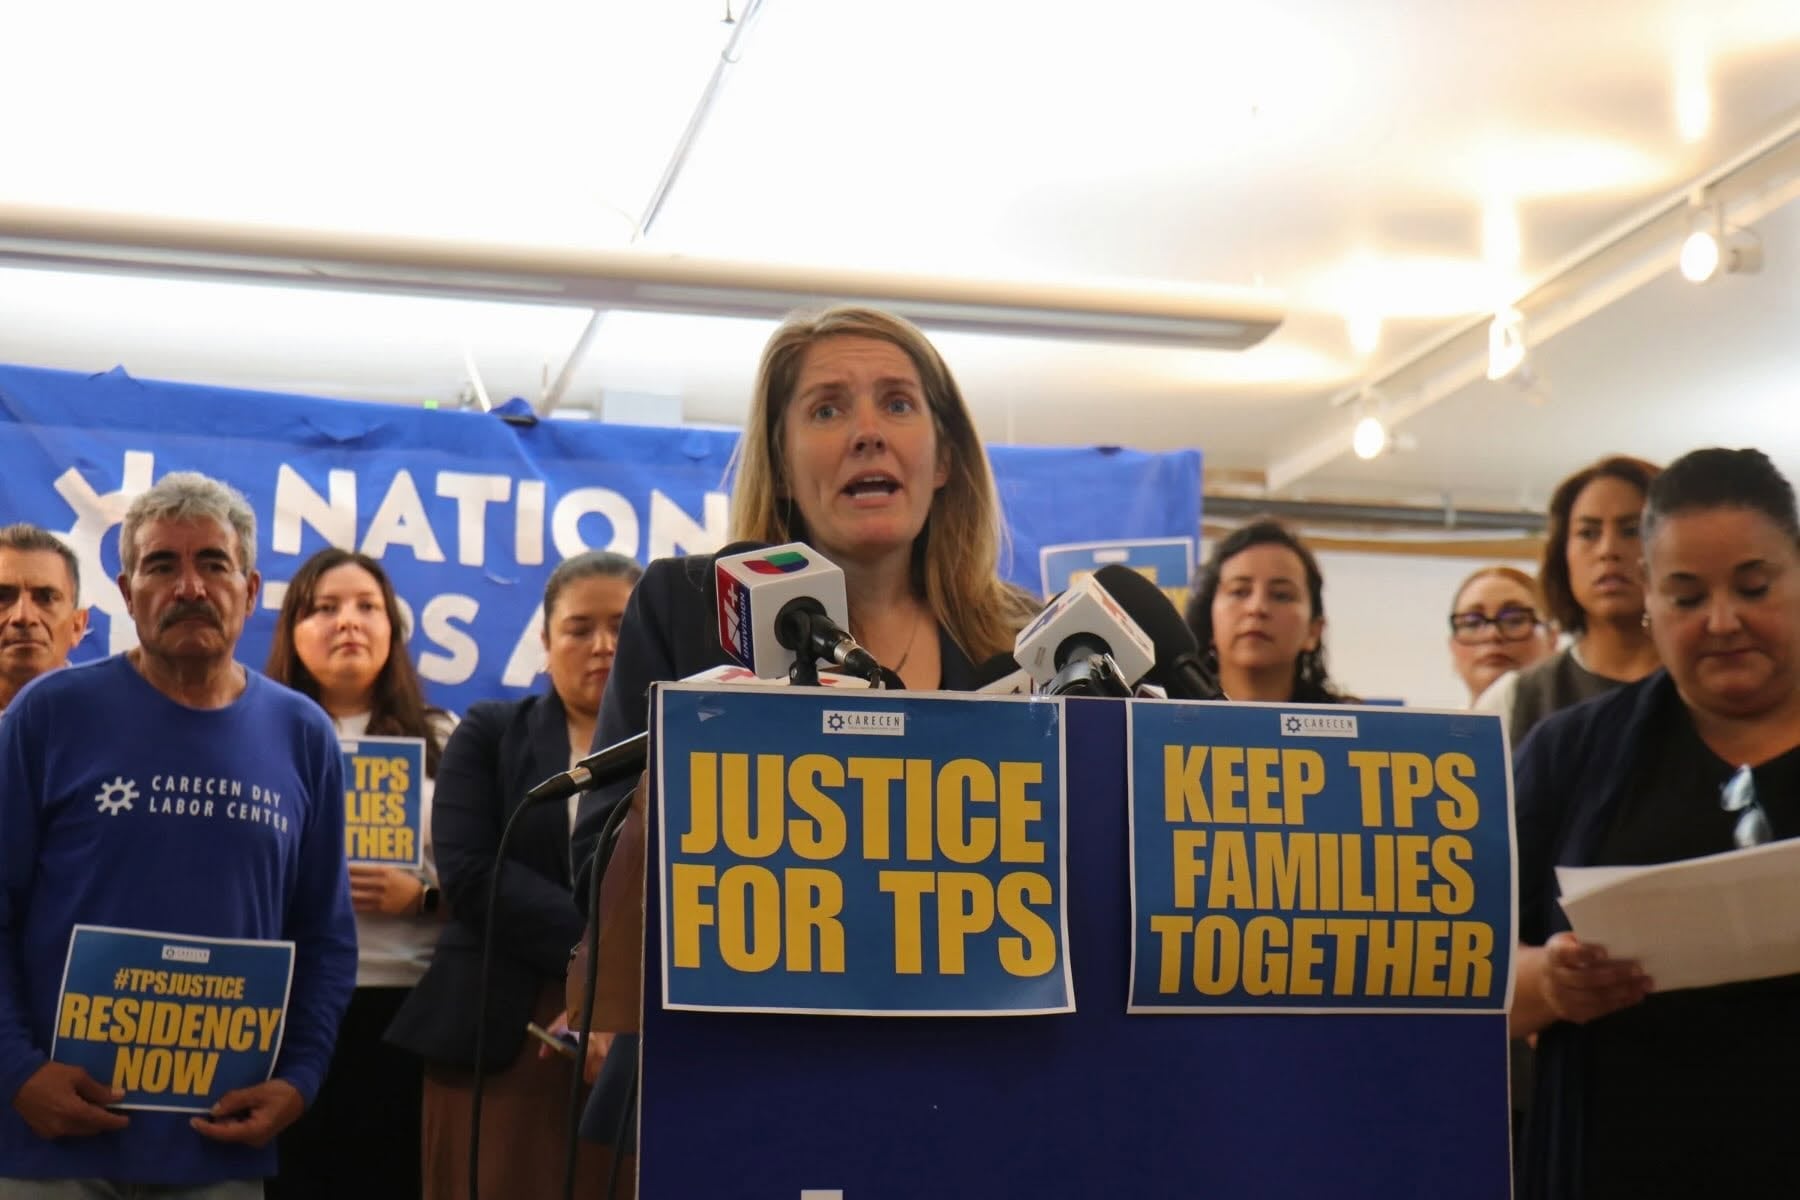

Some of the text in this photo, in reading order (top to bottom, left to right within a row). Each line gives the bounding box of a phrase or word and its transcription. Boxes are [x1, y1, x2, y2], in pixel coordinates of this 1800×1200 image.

[739, 591, 750, 660] UNIVISION
[847, 714, 901, 727] CARECEN
[1303, 718, 1353, 729] CARECEN
[152, 775, 281, 809] CARECEN DAY
[352, 756, 410, 794] TPS
[1163, 744, 1480, 831] KEEP TPS
[149, 796, 289, 834] LABOR CENTER
[680, 751, 1046, 865] JUSTICE
[1172, 829, 1476, 916] FAMILIES
[671, 862, 1058, 978] FOR TPS
[114, 967, 246, 1000] #TPSJUSTICE
[1150, 914, 1495, 998] TOGETHER
[58, 991, 282, 1053] RESIDENCY
[111, 1046, 220, 1096] NOW
